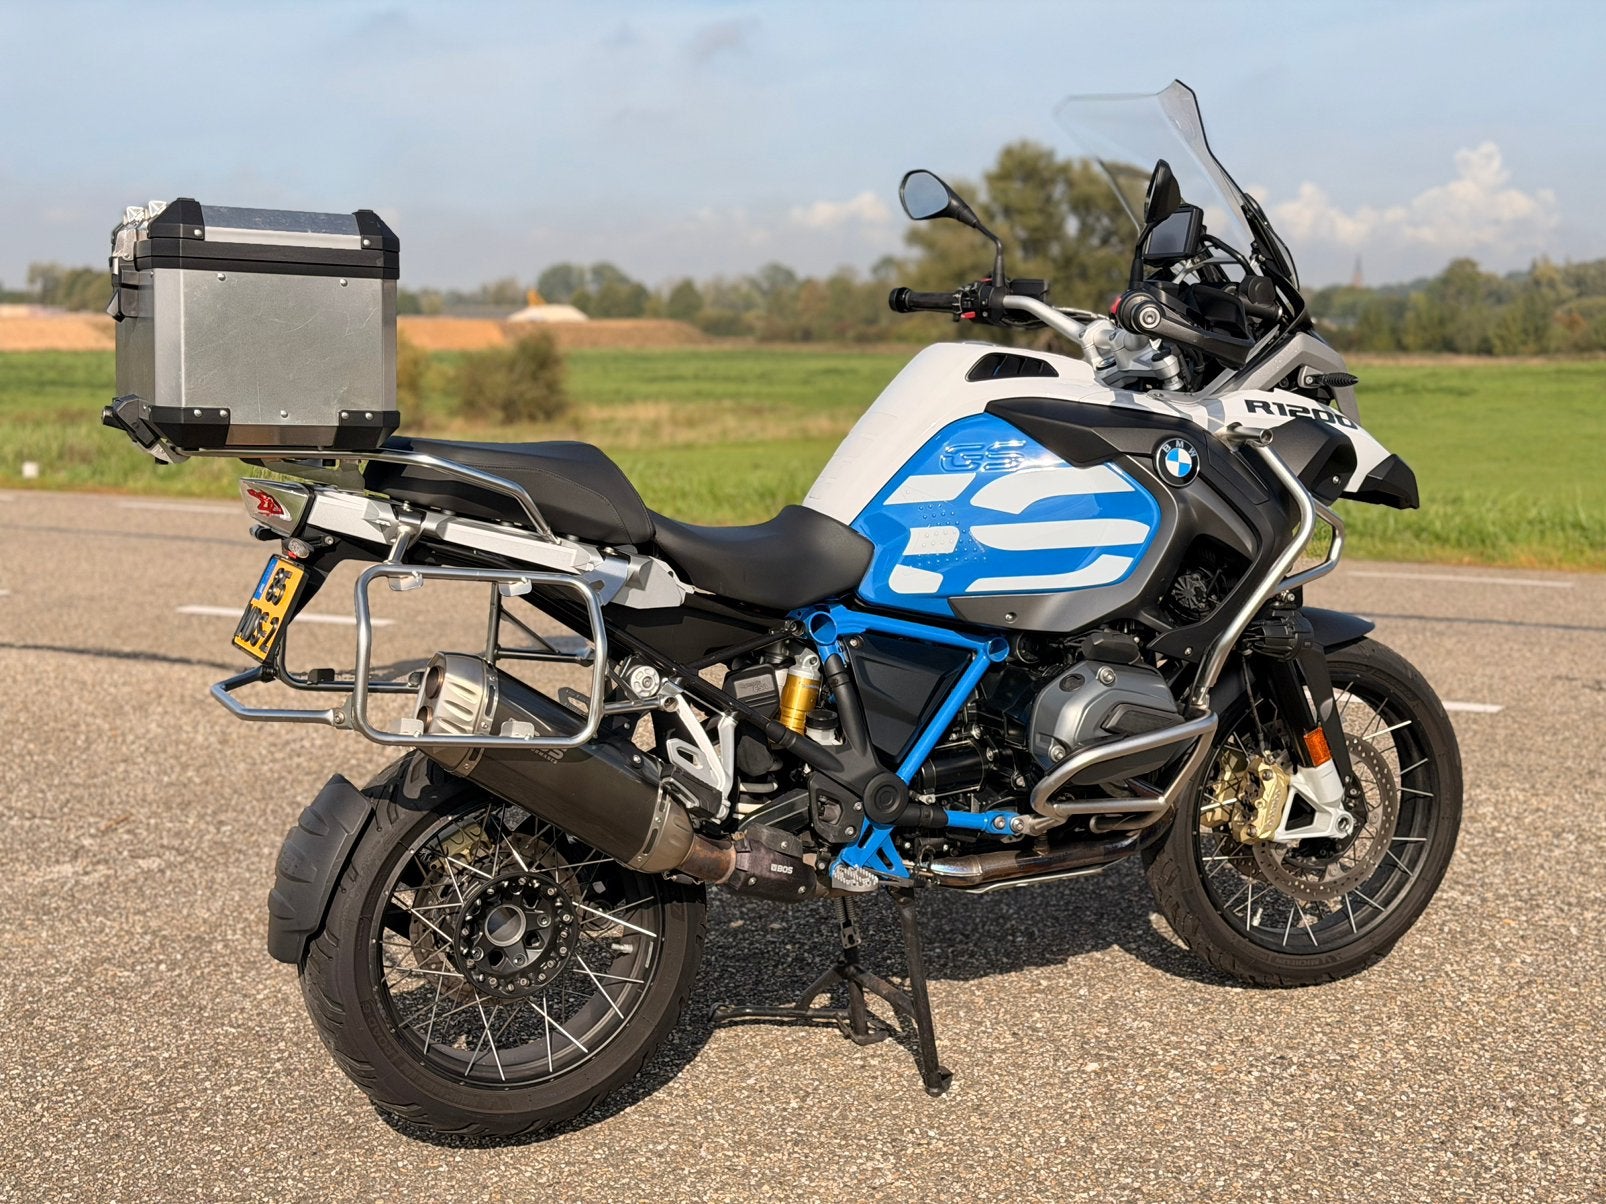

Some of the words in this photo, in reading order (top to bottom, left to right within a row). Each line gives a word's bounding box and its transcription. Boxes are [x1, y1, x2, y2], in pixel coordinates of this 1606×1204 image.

[1244, 399, 1358, 430] R1200
[940, 440, 1027, 472] GS
[1162, 440, 1197, 457] BMW
[777, 864, 794, 875] BOS
